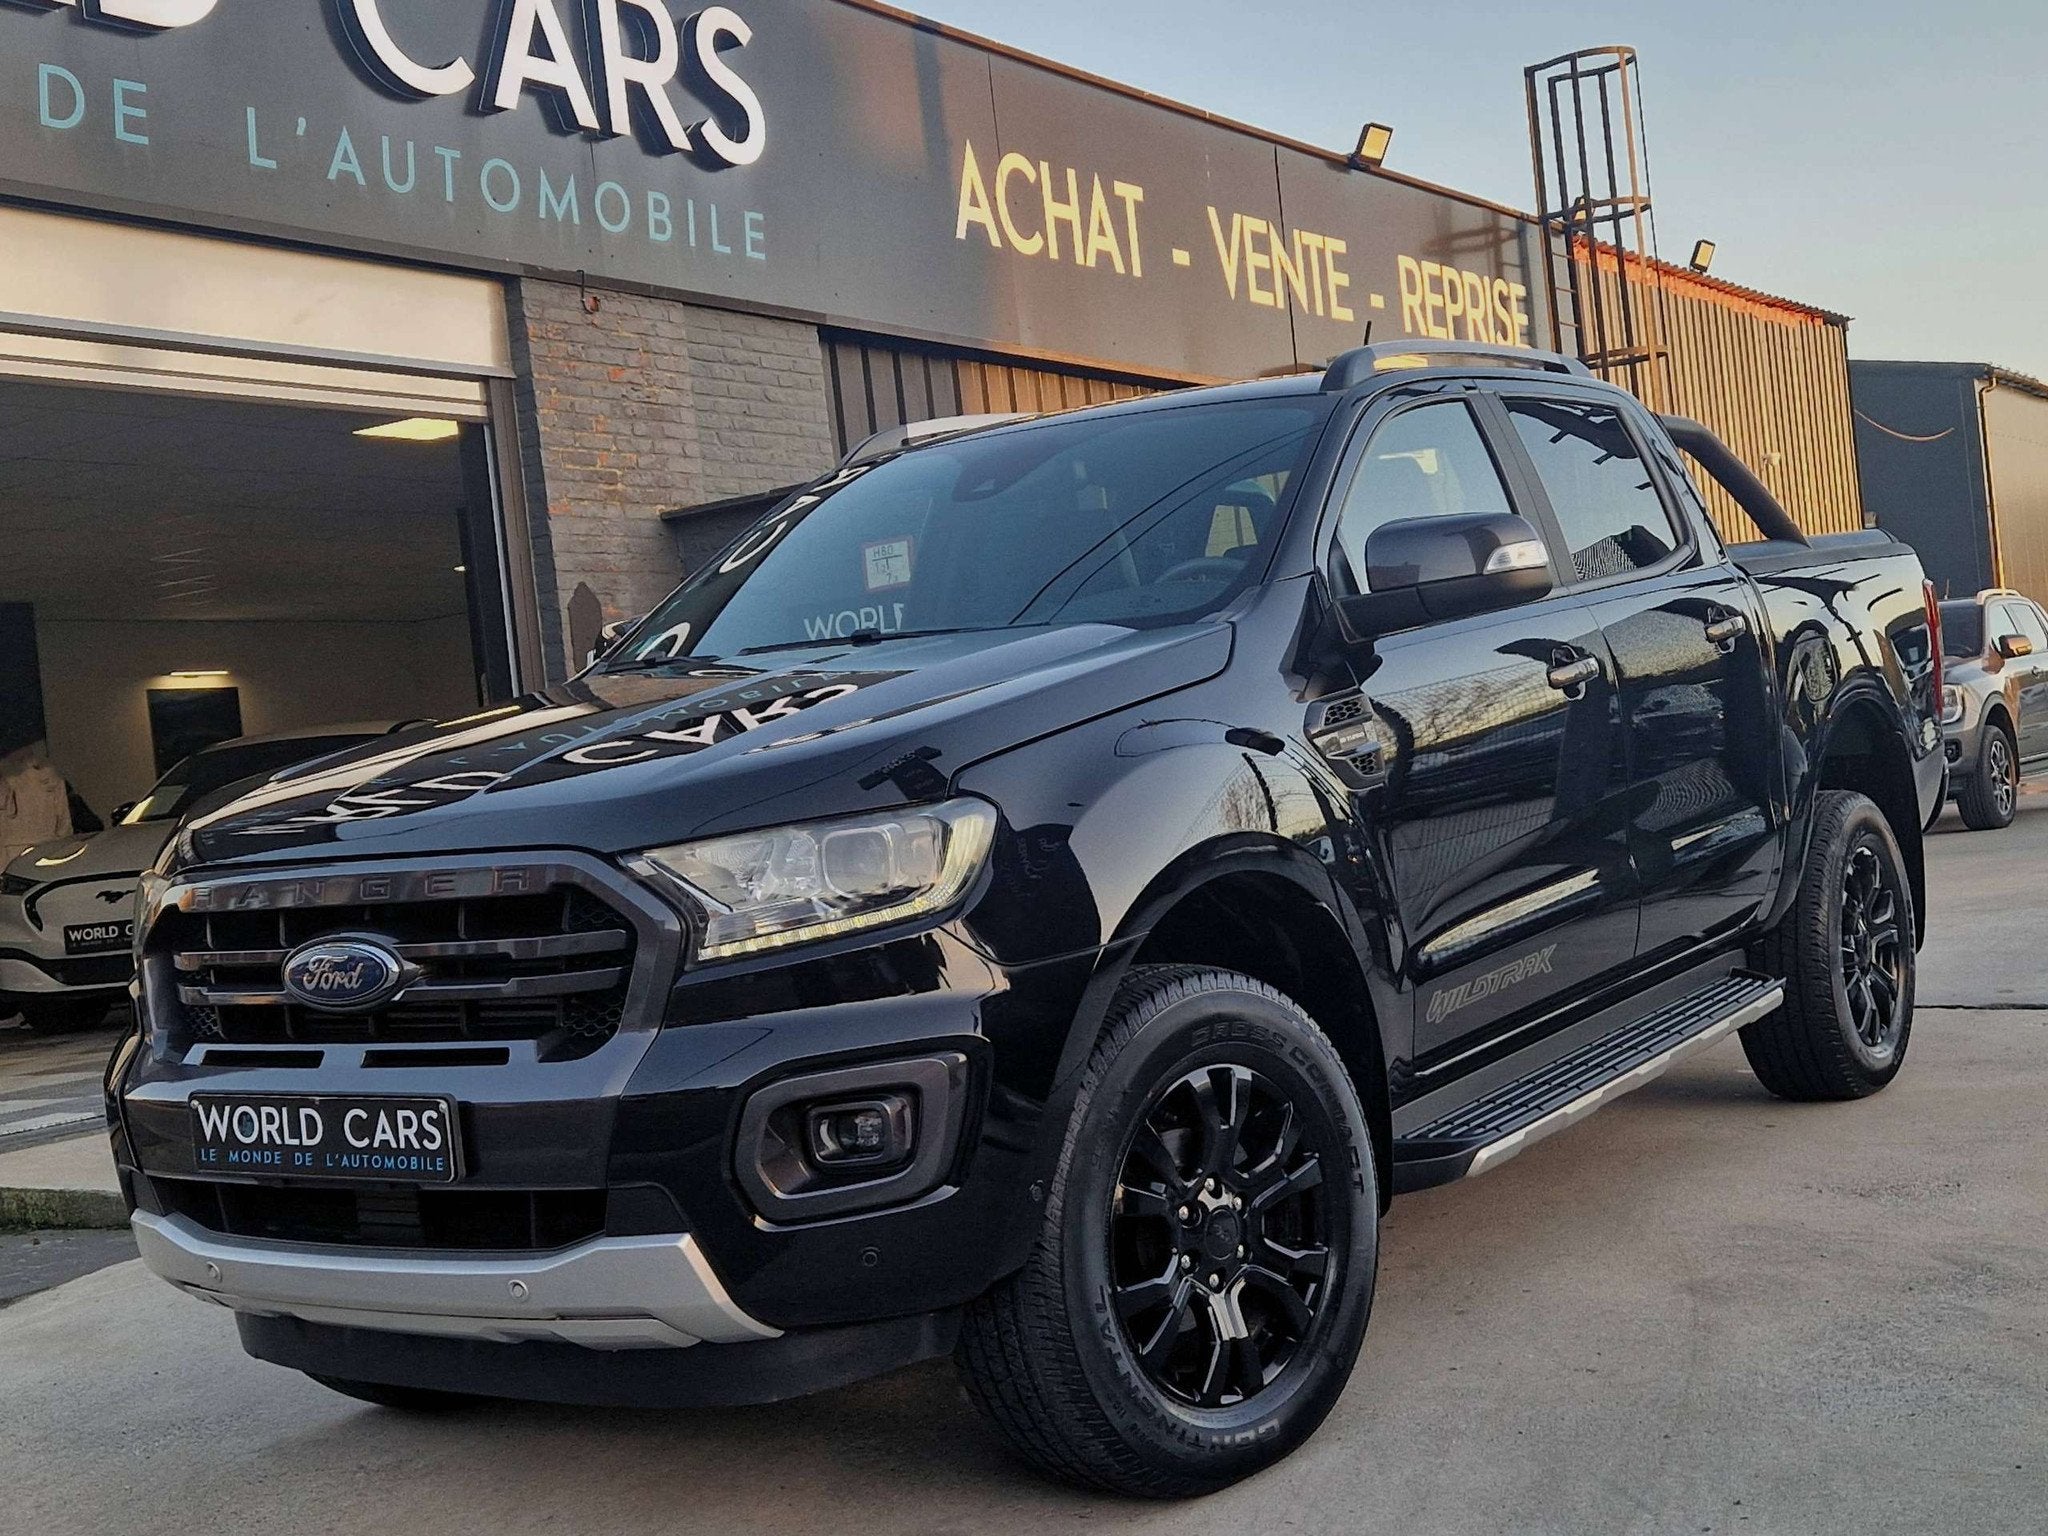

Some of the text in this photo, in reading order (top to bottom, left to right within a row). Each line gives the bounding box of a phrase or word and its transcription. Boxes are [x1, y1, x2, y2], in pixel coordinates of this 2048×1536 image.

[334, 0, 767, 166] CARS
[38, 62, 767, 260] DE L'AUTOMOBILE
[956, 139, 1143, 277] ACHAT
[1207, 206, 1354, 321] VENTE
[1398, 254, 1531, 349] REPRISE
[191, 865, 531, 908] RANGER
[68, 925, 119, 942] WORLD
[302, 954, 363, 991] Ford
[1426, 943, 1557, 1024] WILDTRAK
[197, 1104, 442, 1151] WORLD CARS
[201, 1148, 444, 1172] LE MONDE DE L'AUTOMOBILE
